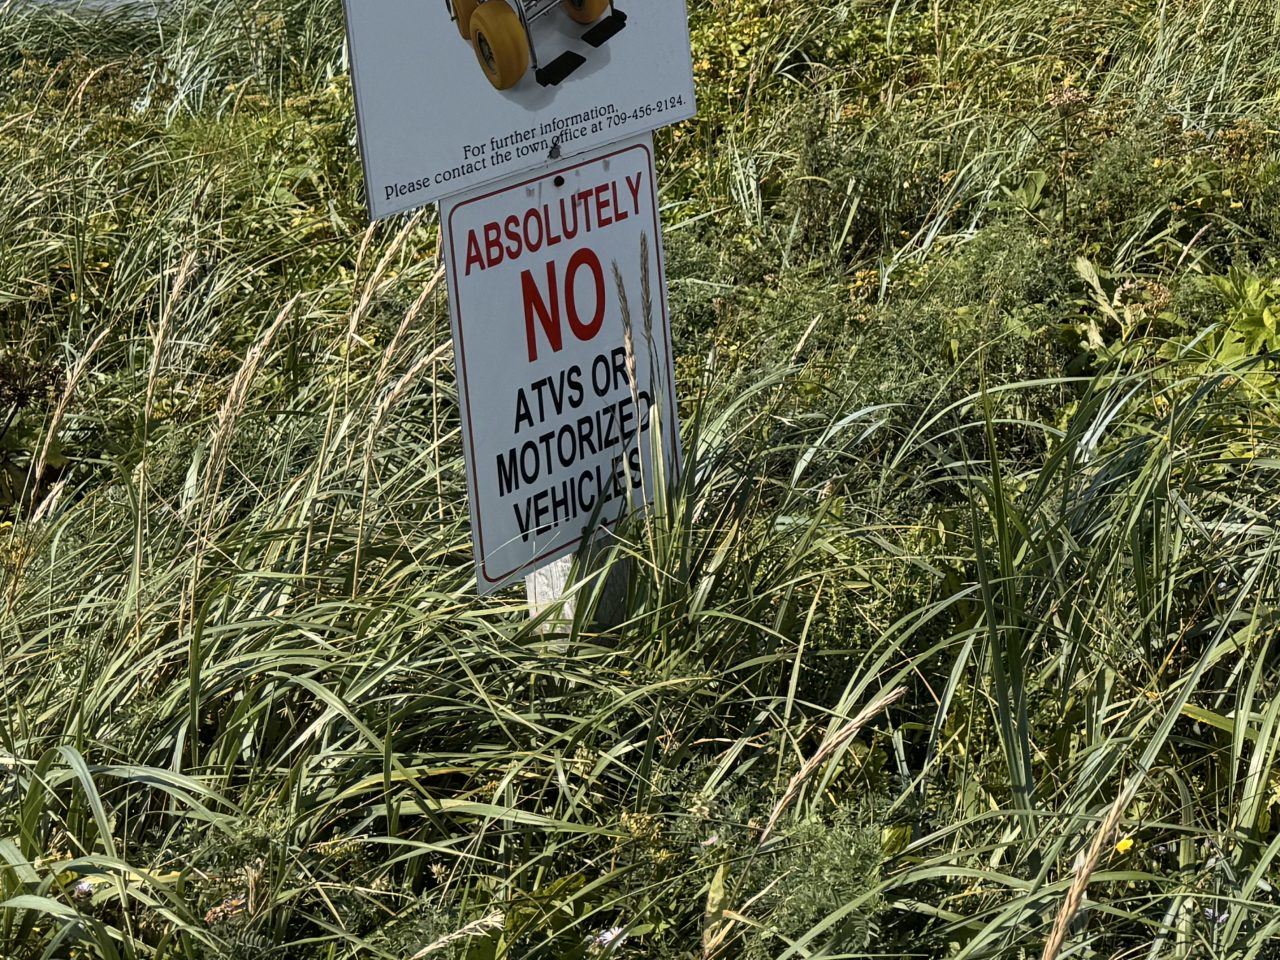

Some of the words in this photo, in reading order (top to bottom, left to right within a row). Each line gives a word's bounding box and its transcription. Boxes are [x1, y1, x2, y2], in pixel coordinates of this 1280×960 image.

[384, 176, 430, 200] Please
[434, 158, 487, 185] contact
[491, 150, 513, 167] the
[516, 139, 548, 158] town
[551, 126, 587, 148] office
[591, 121, 604, 134] at
[463, 144, 487, 160] For
[490, 128, 537, 152] further
[465, 172, 642, 275] ABSOLUTELY
[521, 248, 605, 362] NO
[514, 365, 584, 433] ATVS
[592, 346, 631, 398] OR
[496, 391, 654, 497] MOTORIZED
[513, 446, 644, 543] VEHICLES
